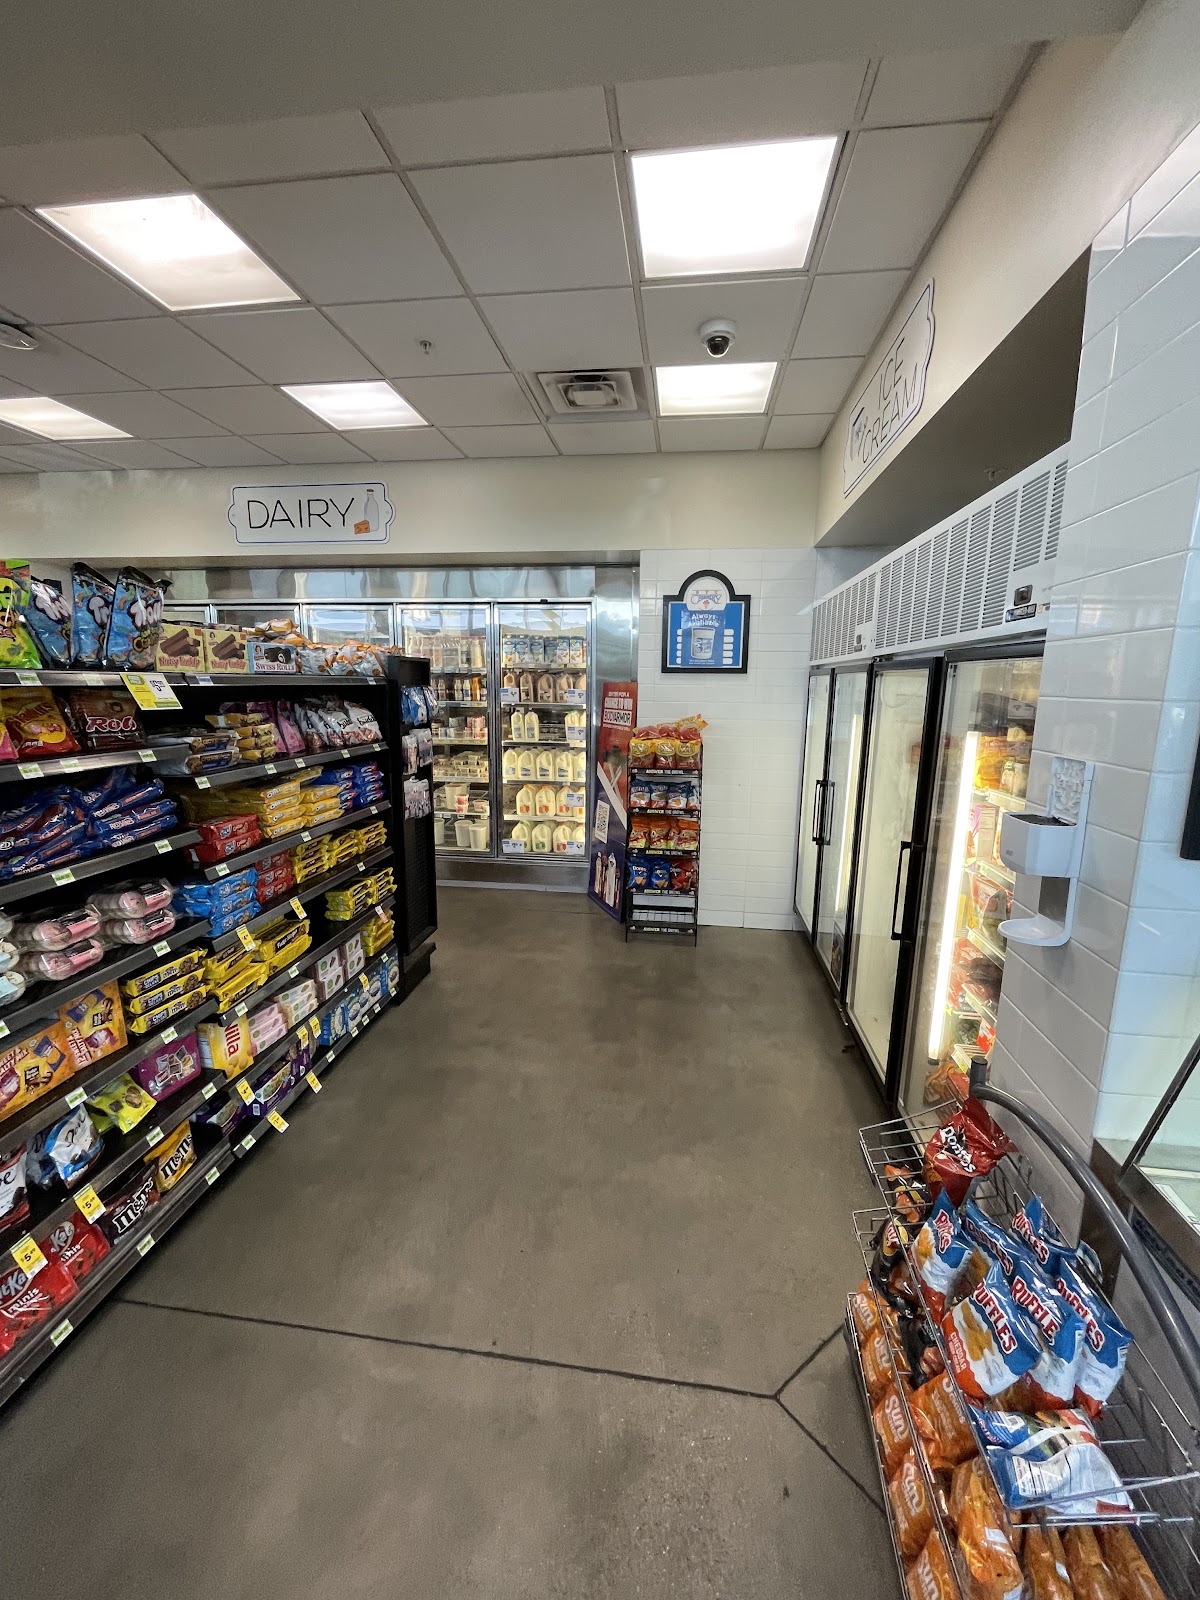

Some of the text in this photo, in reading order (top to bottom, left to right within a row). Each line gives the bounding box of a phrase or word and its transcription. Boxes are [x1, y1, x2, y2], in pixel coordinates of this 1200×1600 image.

[878, 337, 905, 411] ICE
[863, 363, 917, 463] CREAM
[247, 497, 354, 529] DAIRY
[255, 660, 296, 672] SWISS ROLLS
[939, 1125, 976, 1173] Doritos
[8, 1287, 40, 1315] minis
[1010, 1275, 1061, 1346] RUFFLE
[949, 1331, 967, 1370] CHEDDAR
[884, 1394, 908, 1442] Sun
[902, 1461, 925, 1515] Sun
